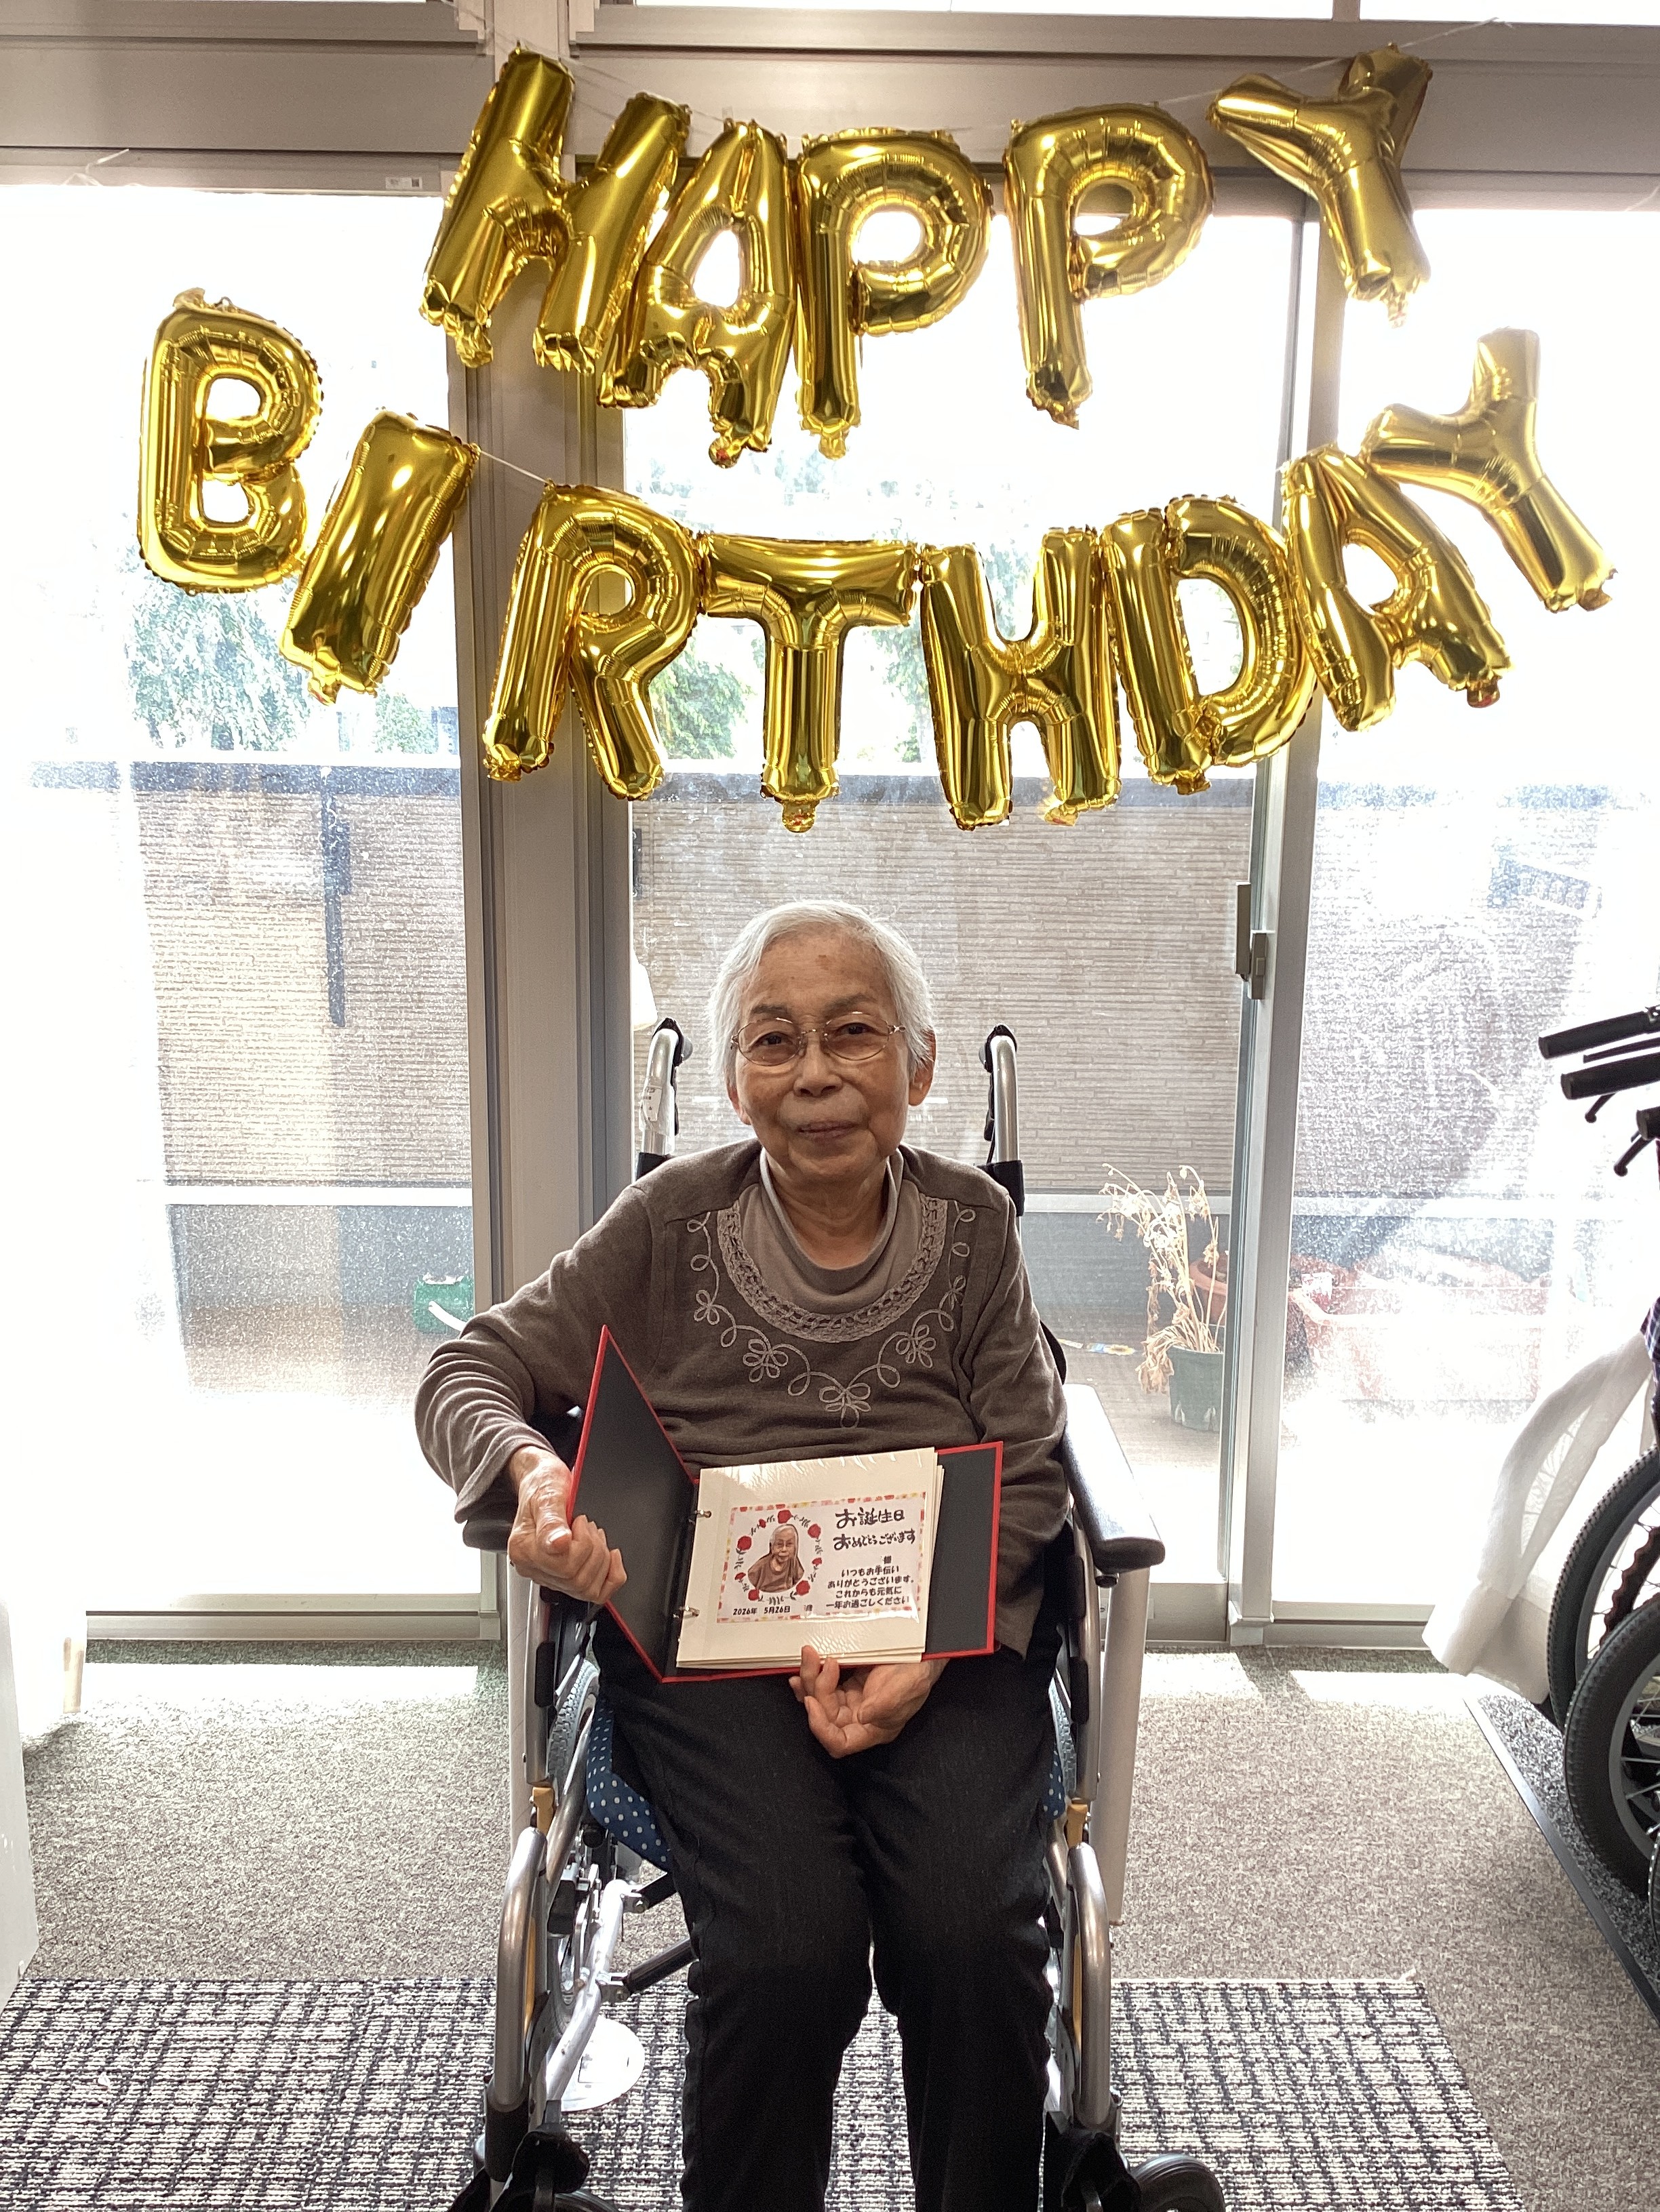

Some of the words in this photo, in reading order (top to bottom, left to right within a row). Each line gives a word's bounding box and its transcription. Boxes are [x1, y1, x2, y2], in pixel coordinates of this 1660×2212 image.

[421, 43, 1432, 468] HAPPY
[138, 287, 1617, 832] BIRTHDAY
[835, 1507, 905, 1529] お誕生日
[833, 1528, 915, 1551] おめでとうございます
[841, 1565, 899, 1577] いつもお手伝い
[827, 1575, 914, 1589] ありがとうございます。
[835, 1586, 902, 1598] これからも元気に
[826, 1596, 909, 1609] 一年お過ごしください
